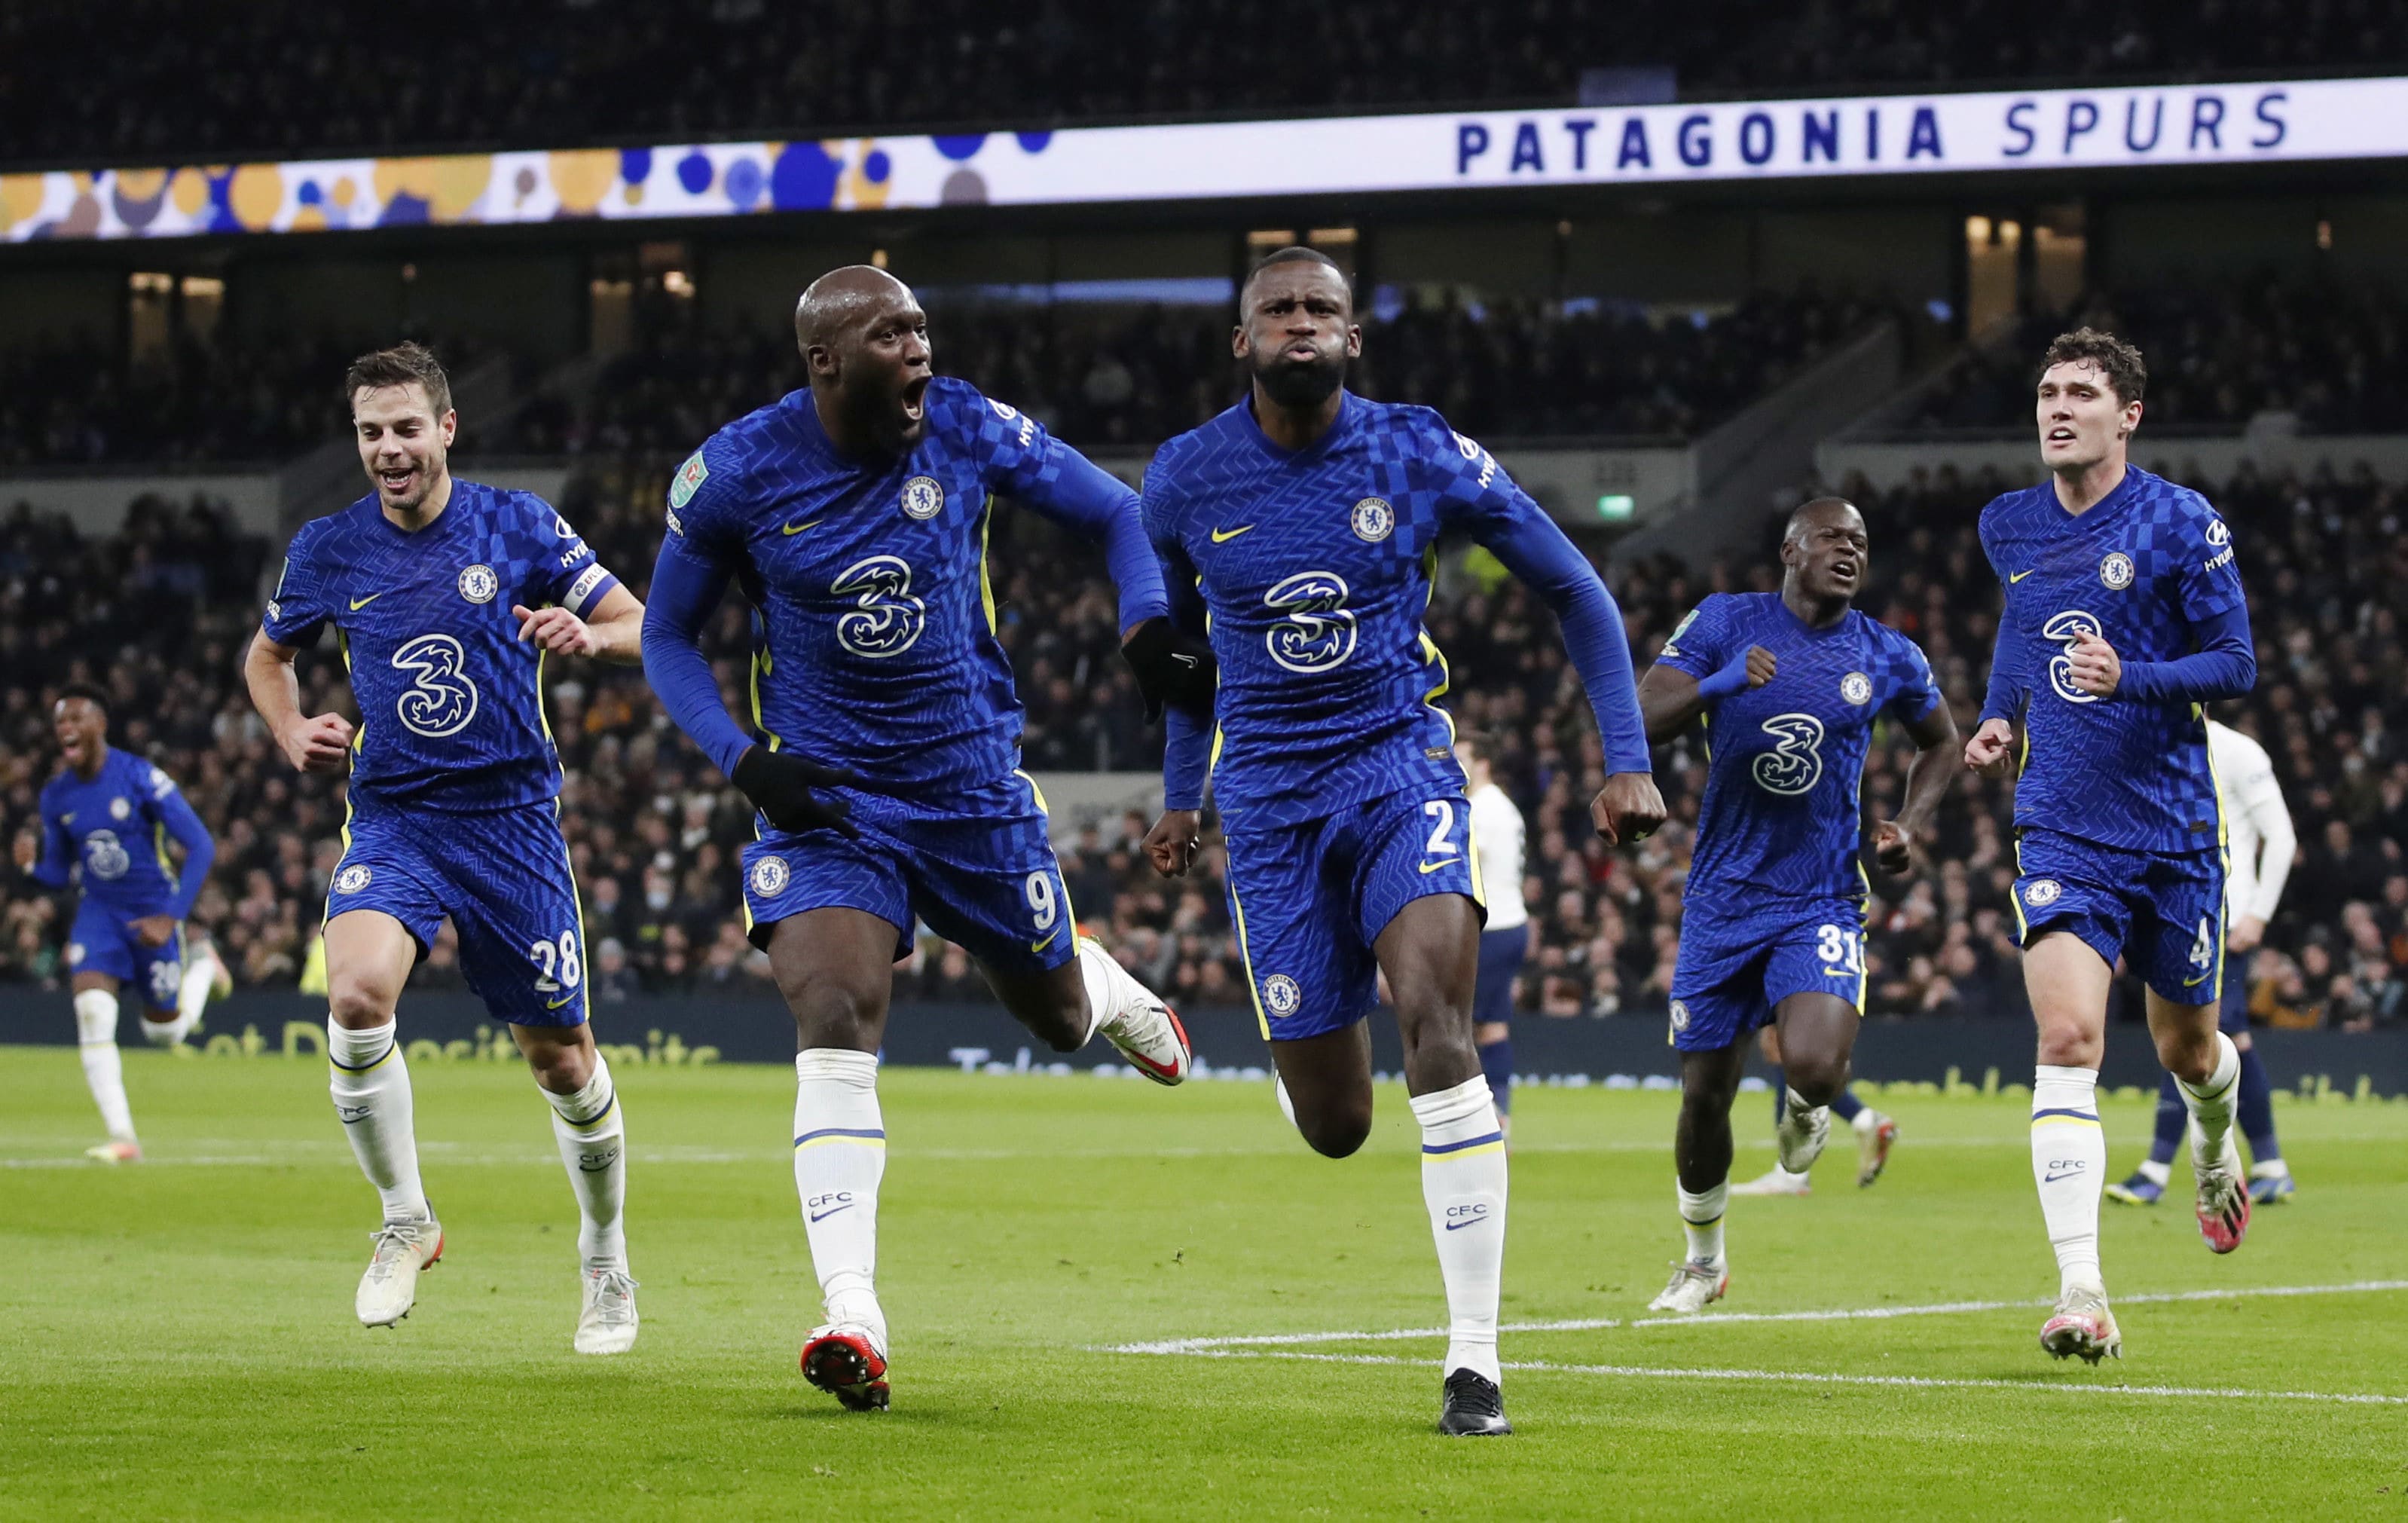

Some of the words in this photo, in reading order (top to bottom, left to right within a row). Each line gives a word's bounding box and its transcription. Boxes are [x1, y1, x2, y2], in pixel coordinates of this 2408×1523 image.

[1458, 107, 1943, 174] PATAGONIA
[2002, 93, 2287, 157] SPURS
[830, 555, 925, 658] 3
[1264, 570, 1357, 673] 3
[392, 634, 478, 737] 3
[1753, 713, 1824, 795] 3
[1425, 800, 1457, 854] 2
[1025, 870, 1056, 930] 9
[530, 930, 580, 992] 28
[1817, 924, 1861, 974] 31
[2189, 917, 2213, 970] 4
[579, 1146, 619, 1163] CFC
[2049, 1160, 2086, 1169] CFC
[808, 1191, 852, 1207] CFC
[1447, 1203, 1487, 1216] CFC
